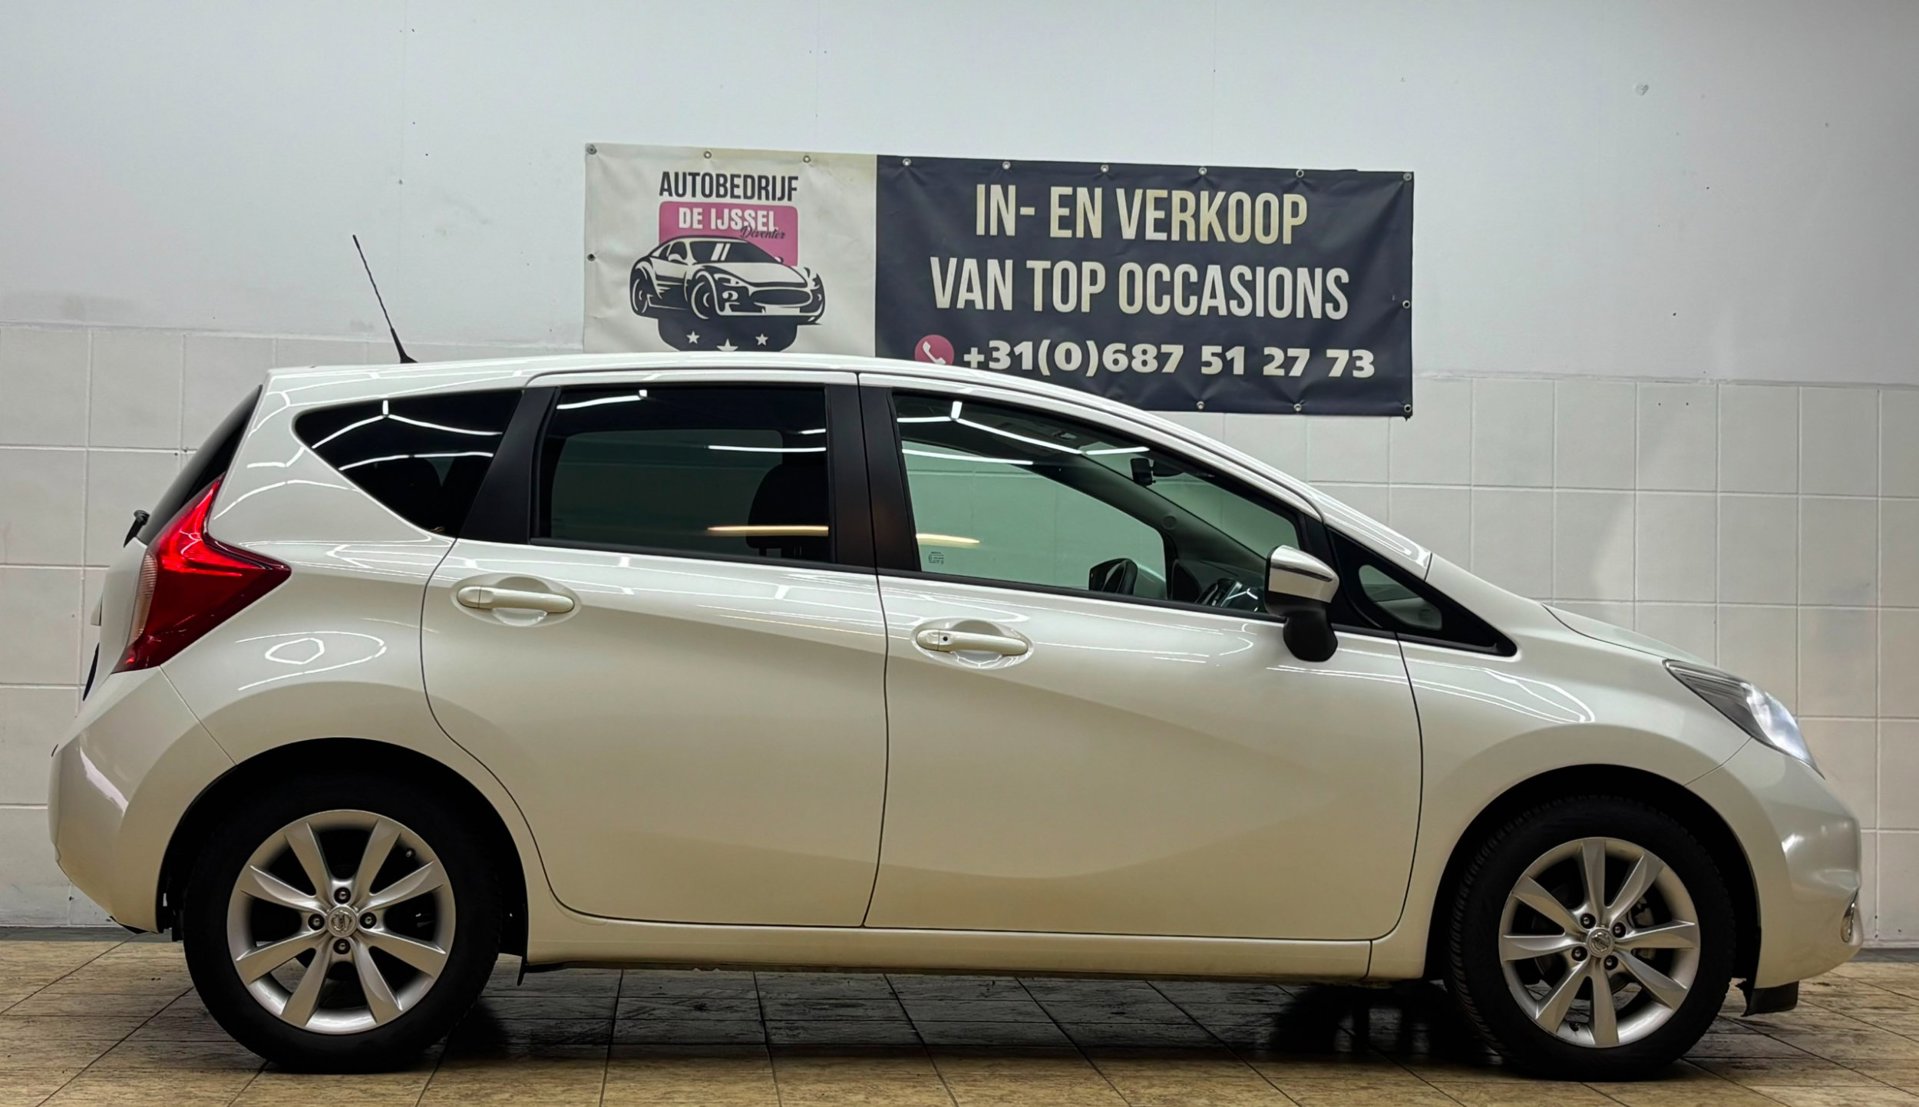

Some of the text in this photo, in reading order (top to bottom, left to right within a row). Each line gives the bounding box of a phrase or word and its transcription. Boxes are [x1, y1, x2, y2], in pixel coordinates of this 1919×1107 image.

[659, 171, 799, 201] AUTOBEDRIJF
[678, 207, 779, 232] DE IJSSEL
[976, 183, 1308, 245] IN- EN VERKOOP
[740, 225, 786, 240] Deventer
[929, 256, 1350, 320] VAN TOP OCCASIONS
[963, 339, 1375, 378] +31(0)687 51 27 73
